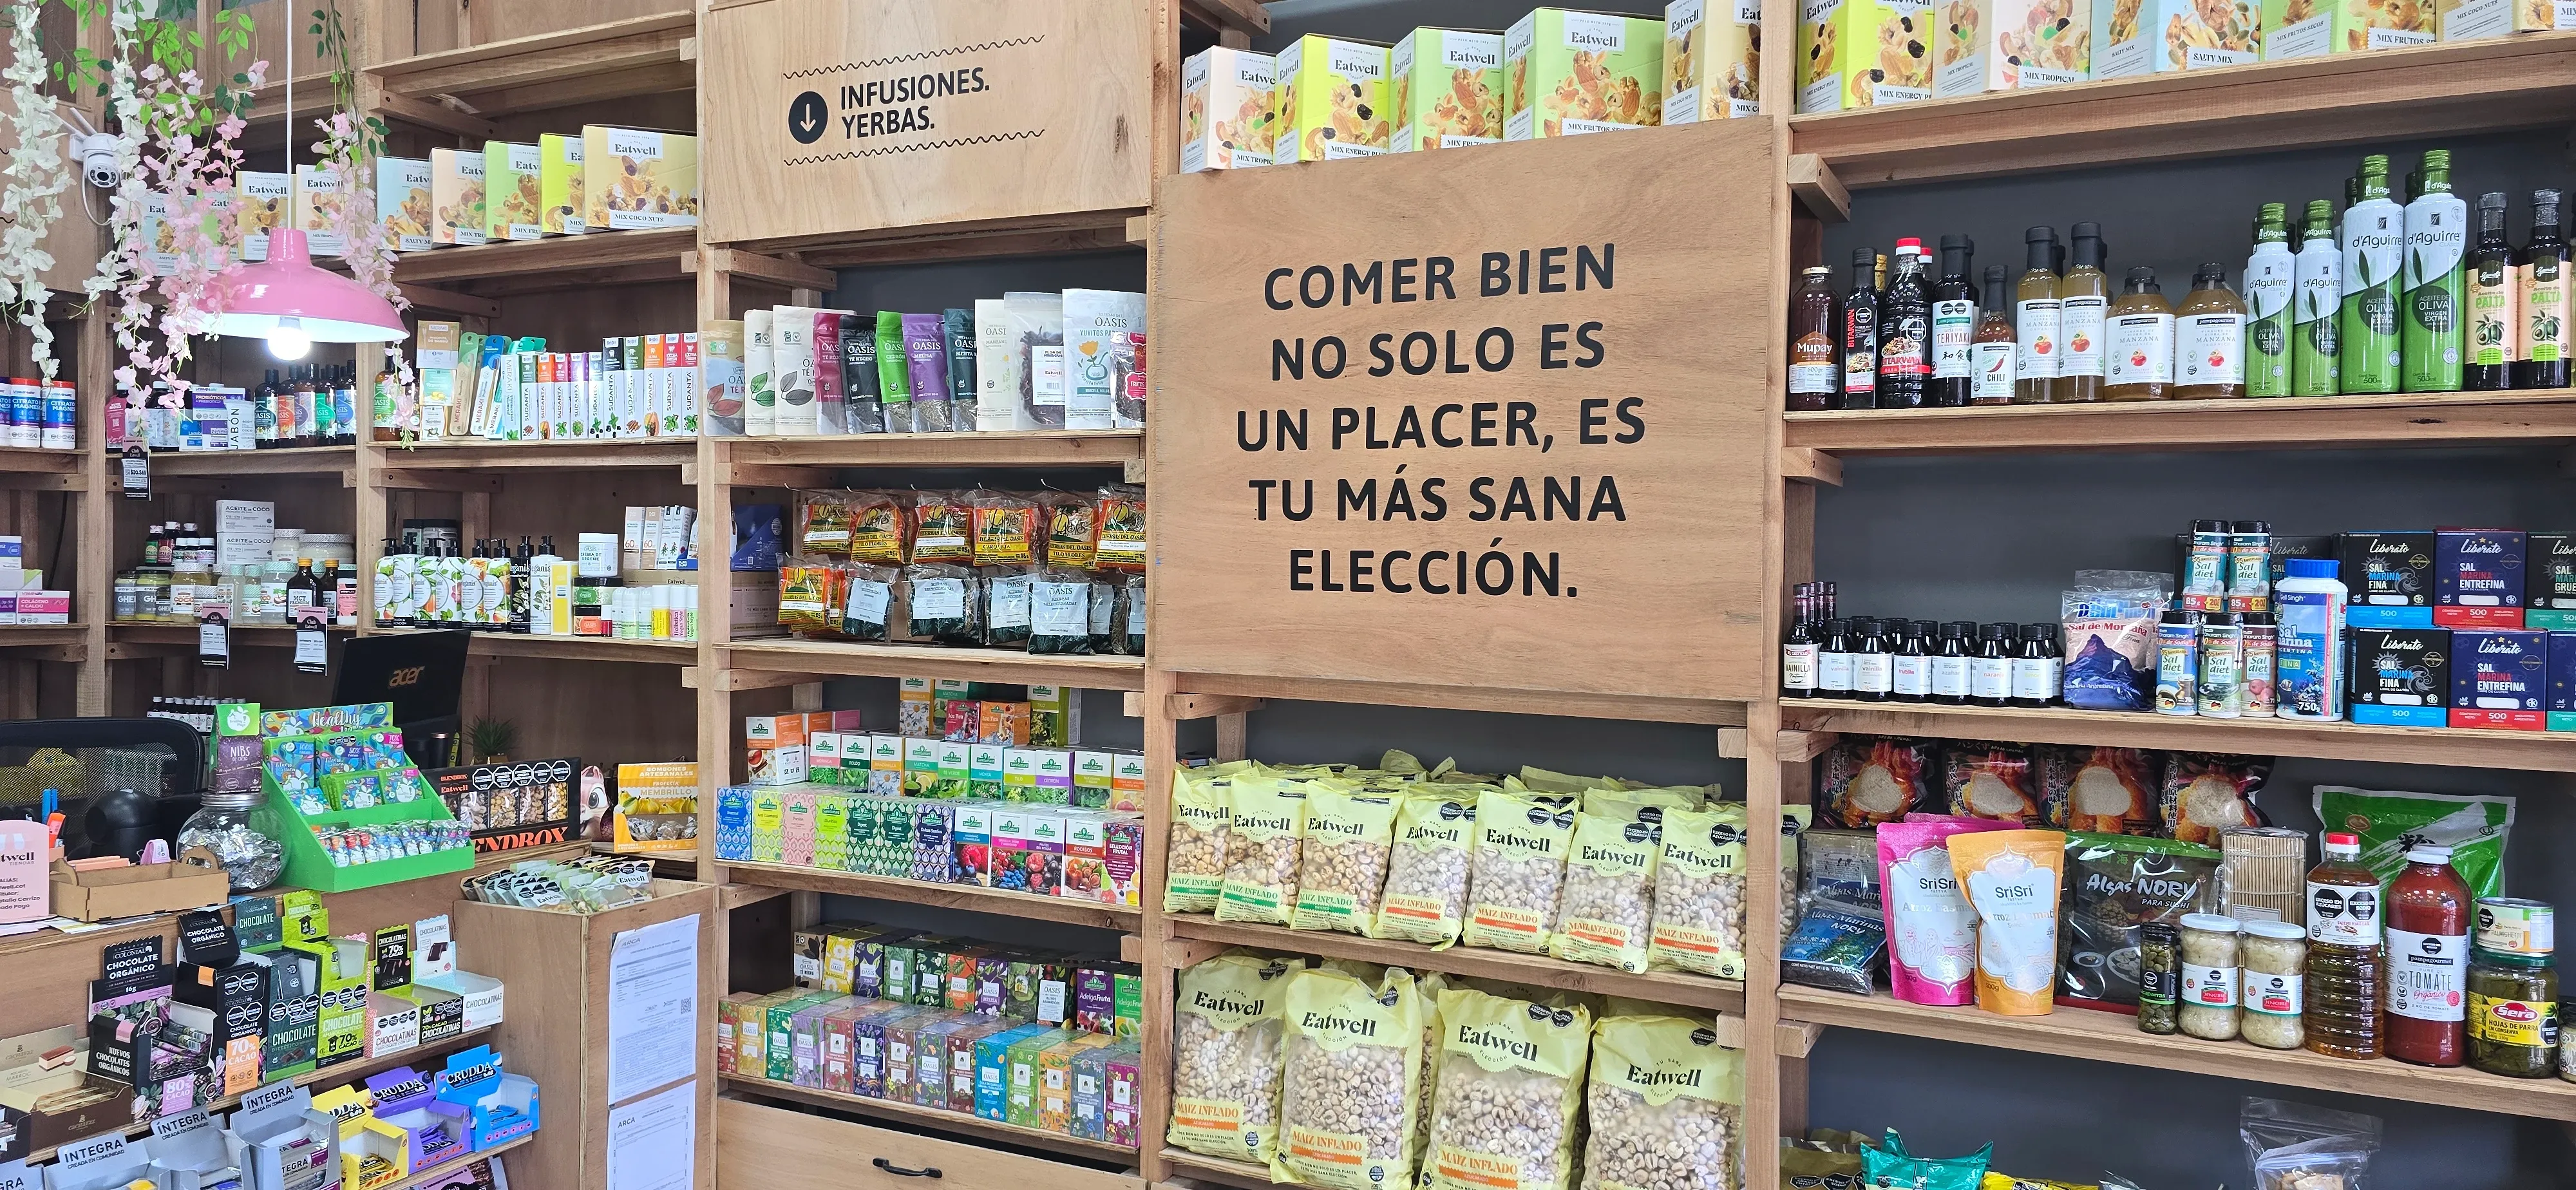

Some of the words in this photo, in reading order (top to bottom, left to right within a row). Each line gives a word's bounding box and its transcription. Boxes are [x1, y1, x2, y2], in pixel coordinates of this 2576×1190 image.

[1571, 32, 1617, 47] Eatwell
[1450, 51, 1495, 64] Eatwell
[2193, 53, 2215, 62] SALTY
[2217, 55, 2233, 64] MIX
[1335, 59, 1378, 75] Eatwell
[840, 67, 990, 110] INFUSIONES.
[842, 106, 934, 139] YERBAS.
[615, 144, 656, 156] Eatwell
[1345, 147, 1370, 156] ENERGY
[2352, 232, 2401, 249] d'Aguirre
[2408, 231, 2459, 248] d'Aguirre
[1264, 257, 1456, 310] COMER
[1481, 243, 1614, 298] BIEN
[2249, 278, 2287, 290] d'Aguirre
[2304, 278, 2340, 288] d'Aguirre
[2418, 301, 2449, 310] OLIVA
[1095, 317, 1127, 328] OASIS
[1937, 332, 1970, 343] TERIYAKI
[2316, 332, 2336, 341] OLIVA
[913, 341, 941, 350] OASIS
[1272, 336, 1347, 381] NO
[1368, 327, 1515, 377] SOLO
[1540, 322, 1605, 370] ES
[1797, 343, 1833, 355] Mupay
[1987, 373, 2005, 382] CHILI
[476, 398, 484, 423] MERAKI
[489, 405, 500, 428] MERAKI
[228, 408, 239, 449] JABÓN
[1237, 409, 1308, 452] UN
[1332, 402, 1553, 453] PLACER,
[1580, 397, 1645, 445] ES
[1249, 479, 1313, 522] TU
[1337, 464, 1448, 522] MÁS
[1468, 476, 1626, 522] SANA
[2370, 540, 2410, 553] Liberato
[2461, 540, 2503, 553] Liberato
[1290, 538, 1577, 597] ELECCIÓN.
[2369, 564, 2384, 572] SAL
[2460, 563, 2476, 571] SAL
[2369, 572, 2401, 581] MARINA
[2369, 581, 2387, 589] FINA
[2460, 580, 2505, 589] ENTREFINA
[2382, 634, 2423, 650] Liberato
[2478, 638, 2522, 654] Liberato
[1786, 664, 1811, 672] VAINILLA
[2163, 656, 2178, 665] Sal
[2210, 657, 2226, 666] Sal
[2380, 661, 2396, 670] SAL
[2478, 663, 2494, 672] SAL
[388, 666, 425, 688] acer
[2380, 679, 2399, 688] FINA
[2478, 682, 2525, 692] ENTREFINA
[312, 711, 361, 728] Healthy
[231, 746, 251, 757] NIBS
[1179, 804, 1229, 818] Eatwell
[1235, 815, 1290, 831] Eatwell
[1308, 817, 1363, 836] Eatwell
[1406, 826, 1458, 842] Eatwell
[1486, 829, 1550, 853] Eatwell
[1582, 845, 1645, 867] Eatwell
[1665, 843, 1731, 869] Eatwell
[2087, 873, 2132, 892] Algas
[2137, 879, 2197, 900] NORY
[240, 913, 274, 928] CHOCOLATE
[1501, 911, 1537, 923] INFLADO
[187, 925, 224, 937] CHOCOLATE
[420, 924, 446, 936] CHOCOLATINAS
[1656, 926, 1677, 936] MAIZ
[1680, 931, 1719, 944] INFLADO
[1831, 922, 1864, 935] NORY
[191, 932, 224, 944] ORGÁNICO
[621, 938, 640, 947] ARCA
[388, 945, 403, 953] 70%
[106, 953, 158, 970] CHOCOLATE
[2411, 955, 2452, 965] pampagourmet
[109, 964, 155, 979] ORGÁNICO
[2409, 971, 2451, 991] TOMATE
[466, 993, 502, 1008] CHOCOLATINAS
[1080, 993, 1111, 1003] AdelgoFruta
[1194, 991, 1264, 1015] Eatwell
[2498, 1007, 2535, 1019] Sera
[1302, 1012, 1376, 1037] Eatwell
[2488, 1019, 2505, 1028] HOJAS
[272, 1025, 316, 1045] CHOCOLATE
[376, 1028, 417, 1046] CHOCOLATINAS
[231, 1039, 256, 1054] 70%
[1459, 1025, 1537, 1062] Eatwell
[97, 1052, 130, 1068] CHOCOLATES
[108, 1046, 130, 1059] NUEVOS
[229, 1052, 257, 1066] CACAO
[98, 1061, 129, 1077] ORGÁNICOS
[446, 1062, 492, 1083] CRUDDA
[1627, 1064, 1701, 1088] Eatwell
[373, 1079, 423, 1099] CRUDDA
[1177, 1102, 1196, 1114] MAIZ
[1198, 1104, 1238, 1118] INFLADO
[618, 1117, 635, 1128] ARCA
[1293, 1130, 1314, 1144] MAIZ
[1317, 1136, 1362, 1151] INFLADO
[68, 1160, 87, 1169] CREADA
[98, 1149, 124, 1162] COMUNIDAD
[1442, 1151, 1466, 1166] MAIZ
[1468, 1158, 1518, 1175] INFLADO
